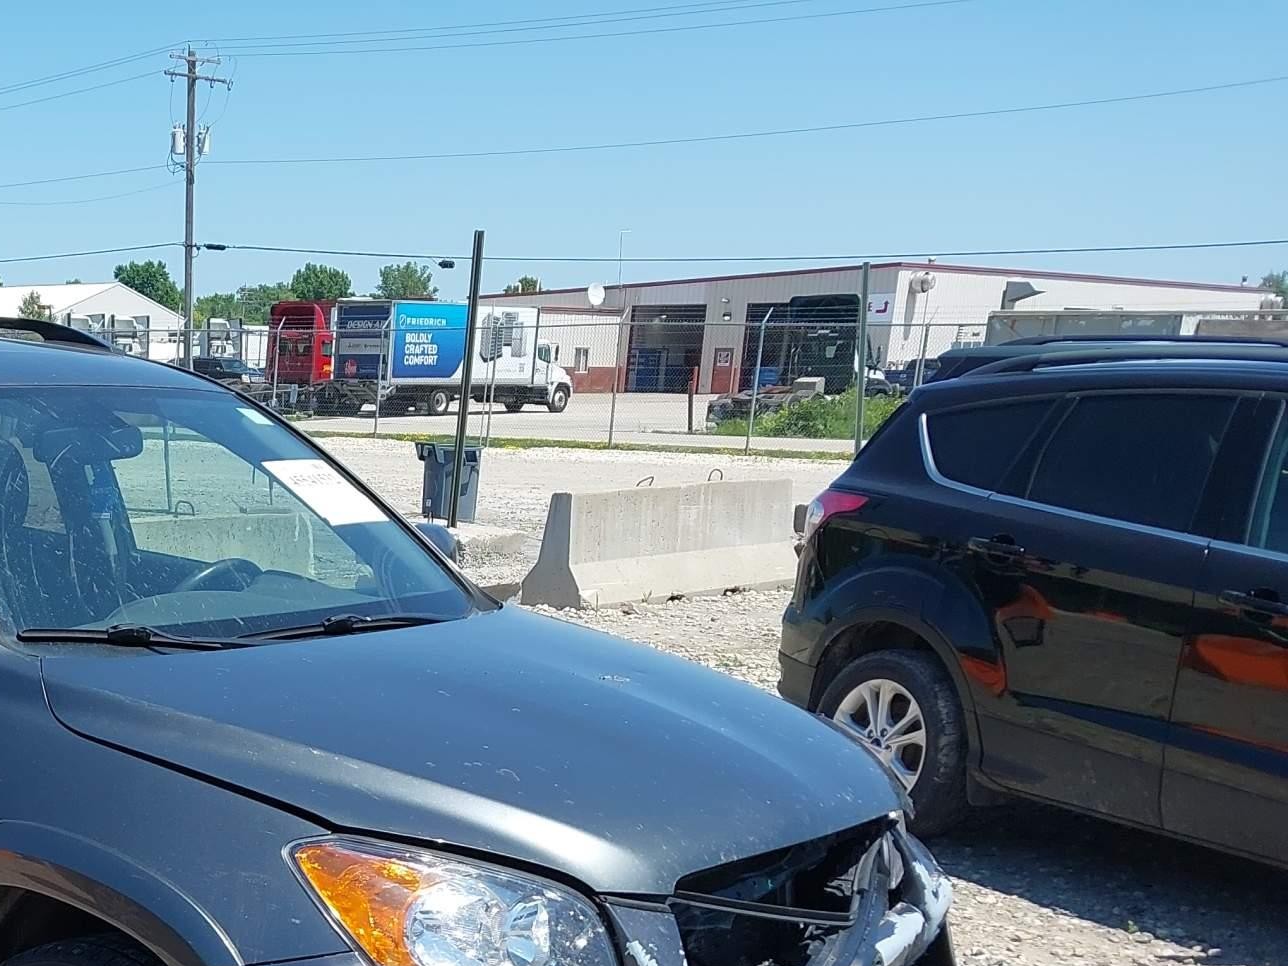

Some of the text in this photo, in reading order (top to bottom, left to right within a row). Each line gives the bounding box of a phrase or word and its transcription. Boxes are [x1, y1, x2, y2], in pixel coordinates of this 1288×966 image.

[407, 317, 447, 326] FRIEDRICH
[405, 332, 433, 343] BOLDLY
[404, 343, 438, 355] CRAFTED
[403, 355, 439, 366] COMFORT
